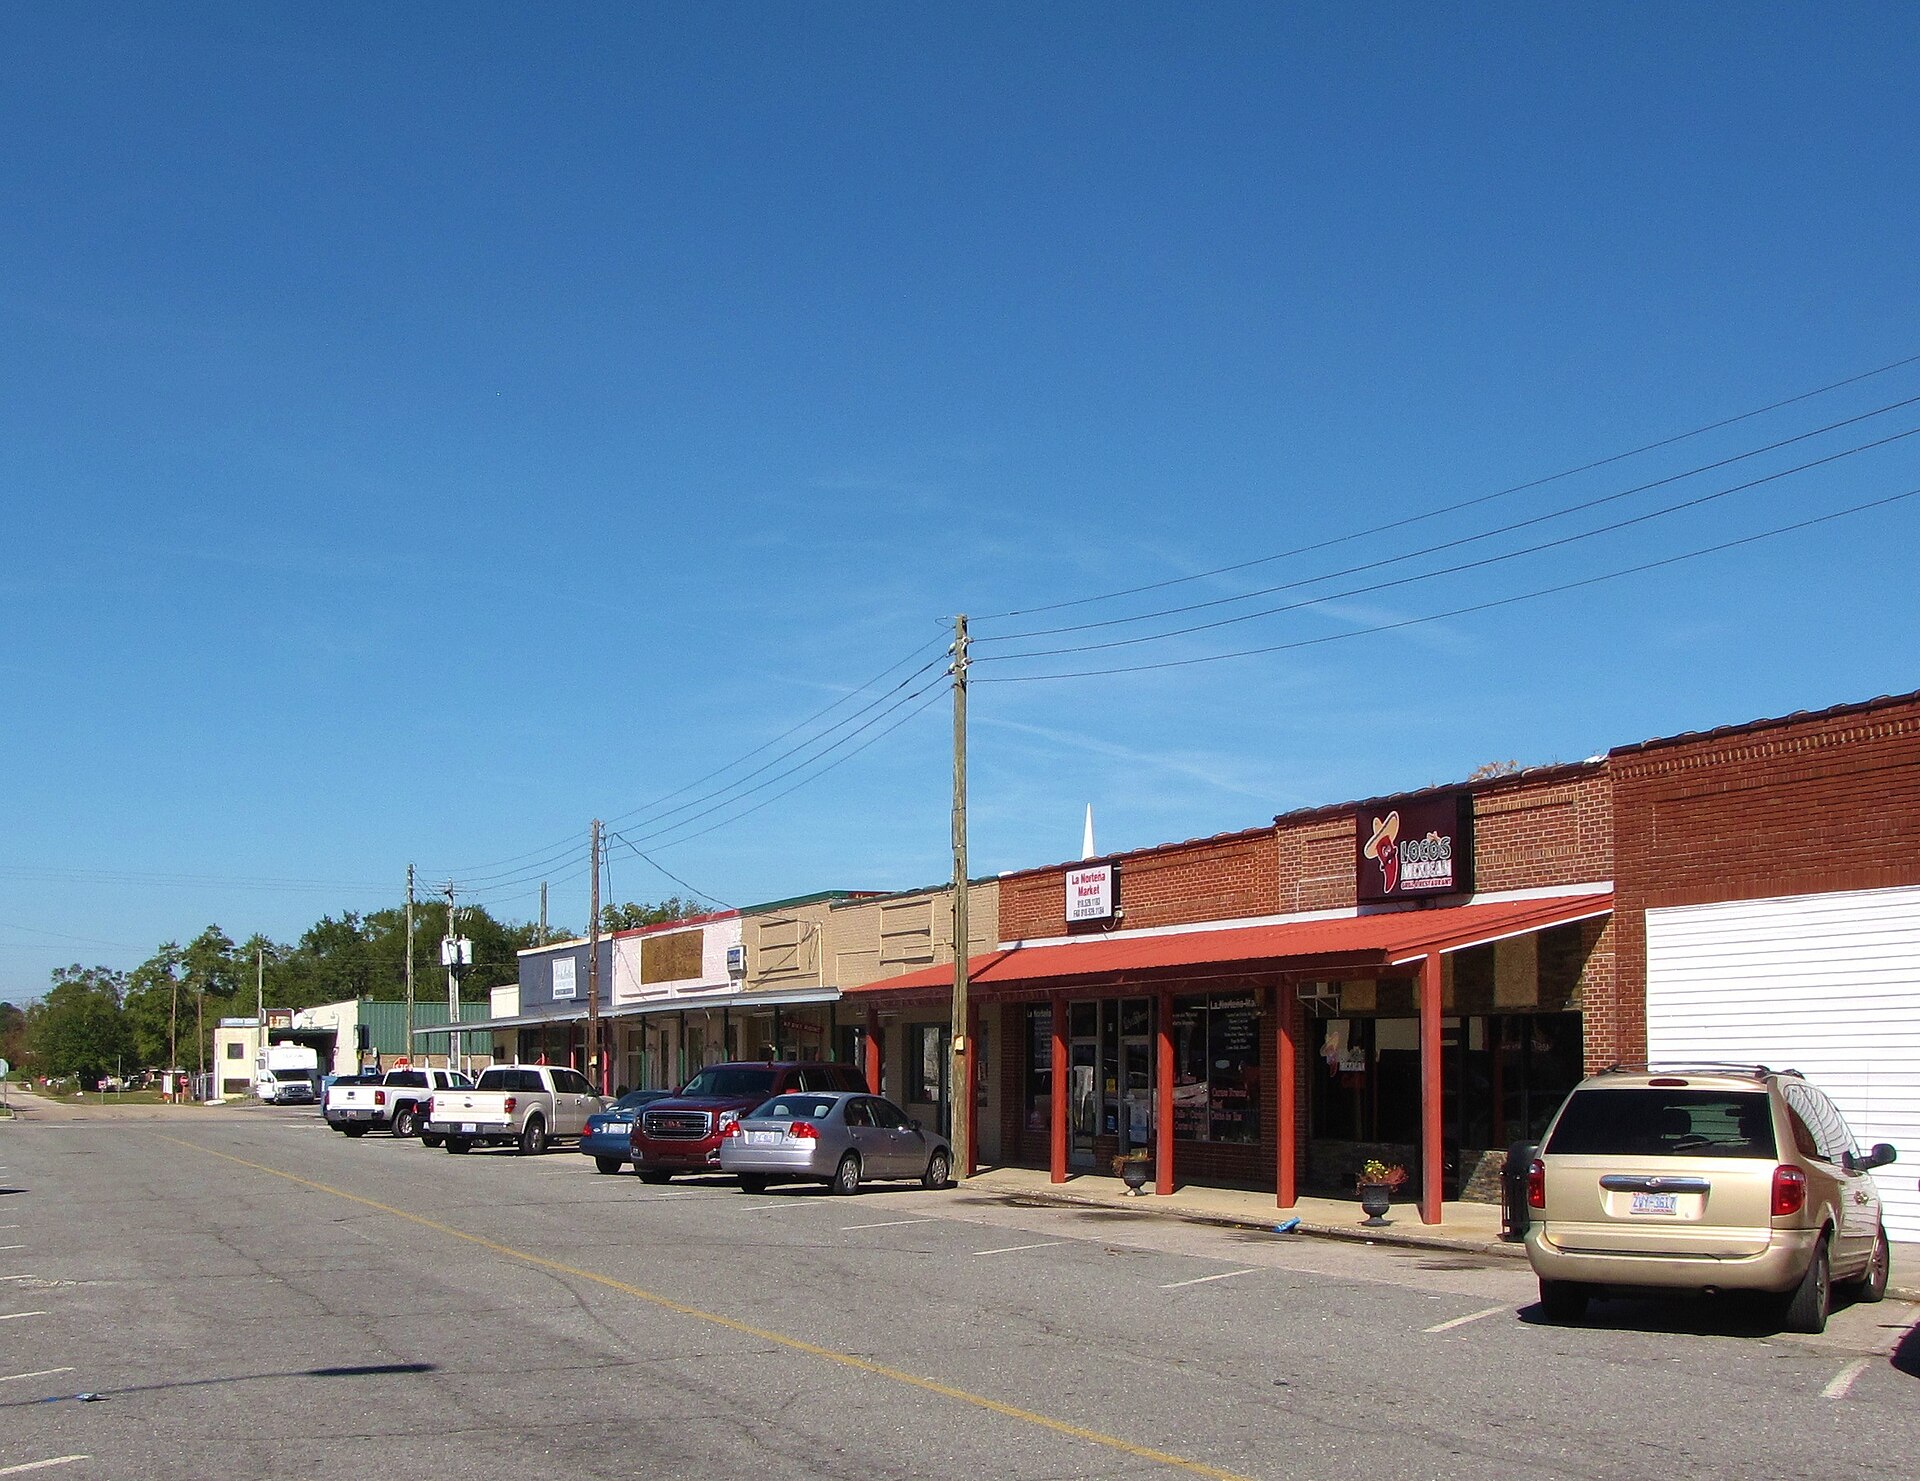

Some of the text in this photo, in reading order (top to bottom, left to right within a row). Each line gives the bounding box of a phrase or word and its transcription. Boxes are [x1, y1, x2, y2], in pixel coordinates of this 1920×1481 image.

[1400, 836, 1452, 863] LOCOS
[1071, 871, 1106, 885] La Norteña
[1400, 859, 1452, 880] MEXICAN
[1078, 884, 1100, 896] Market
